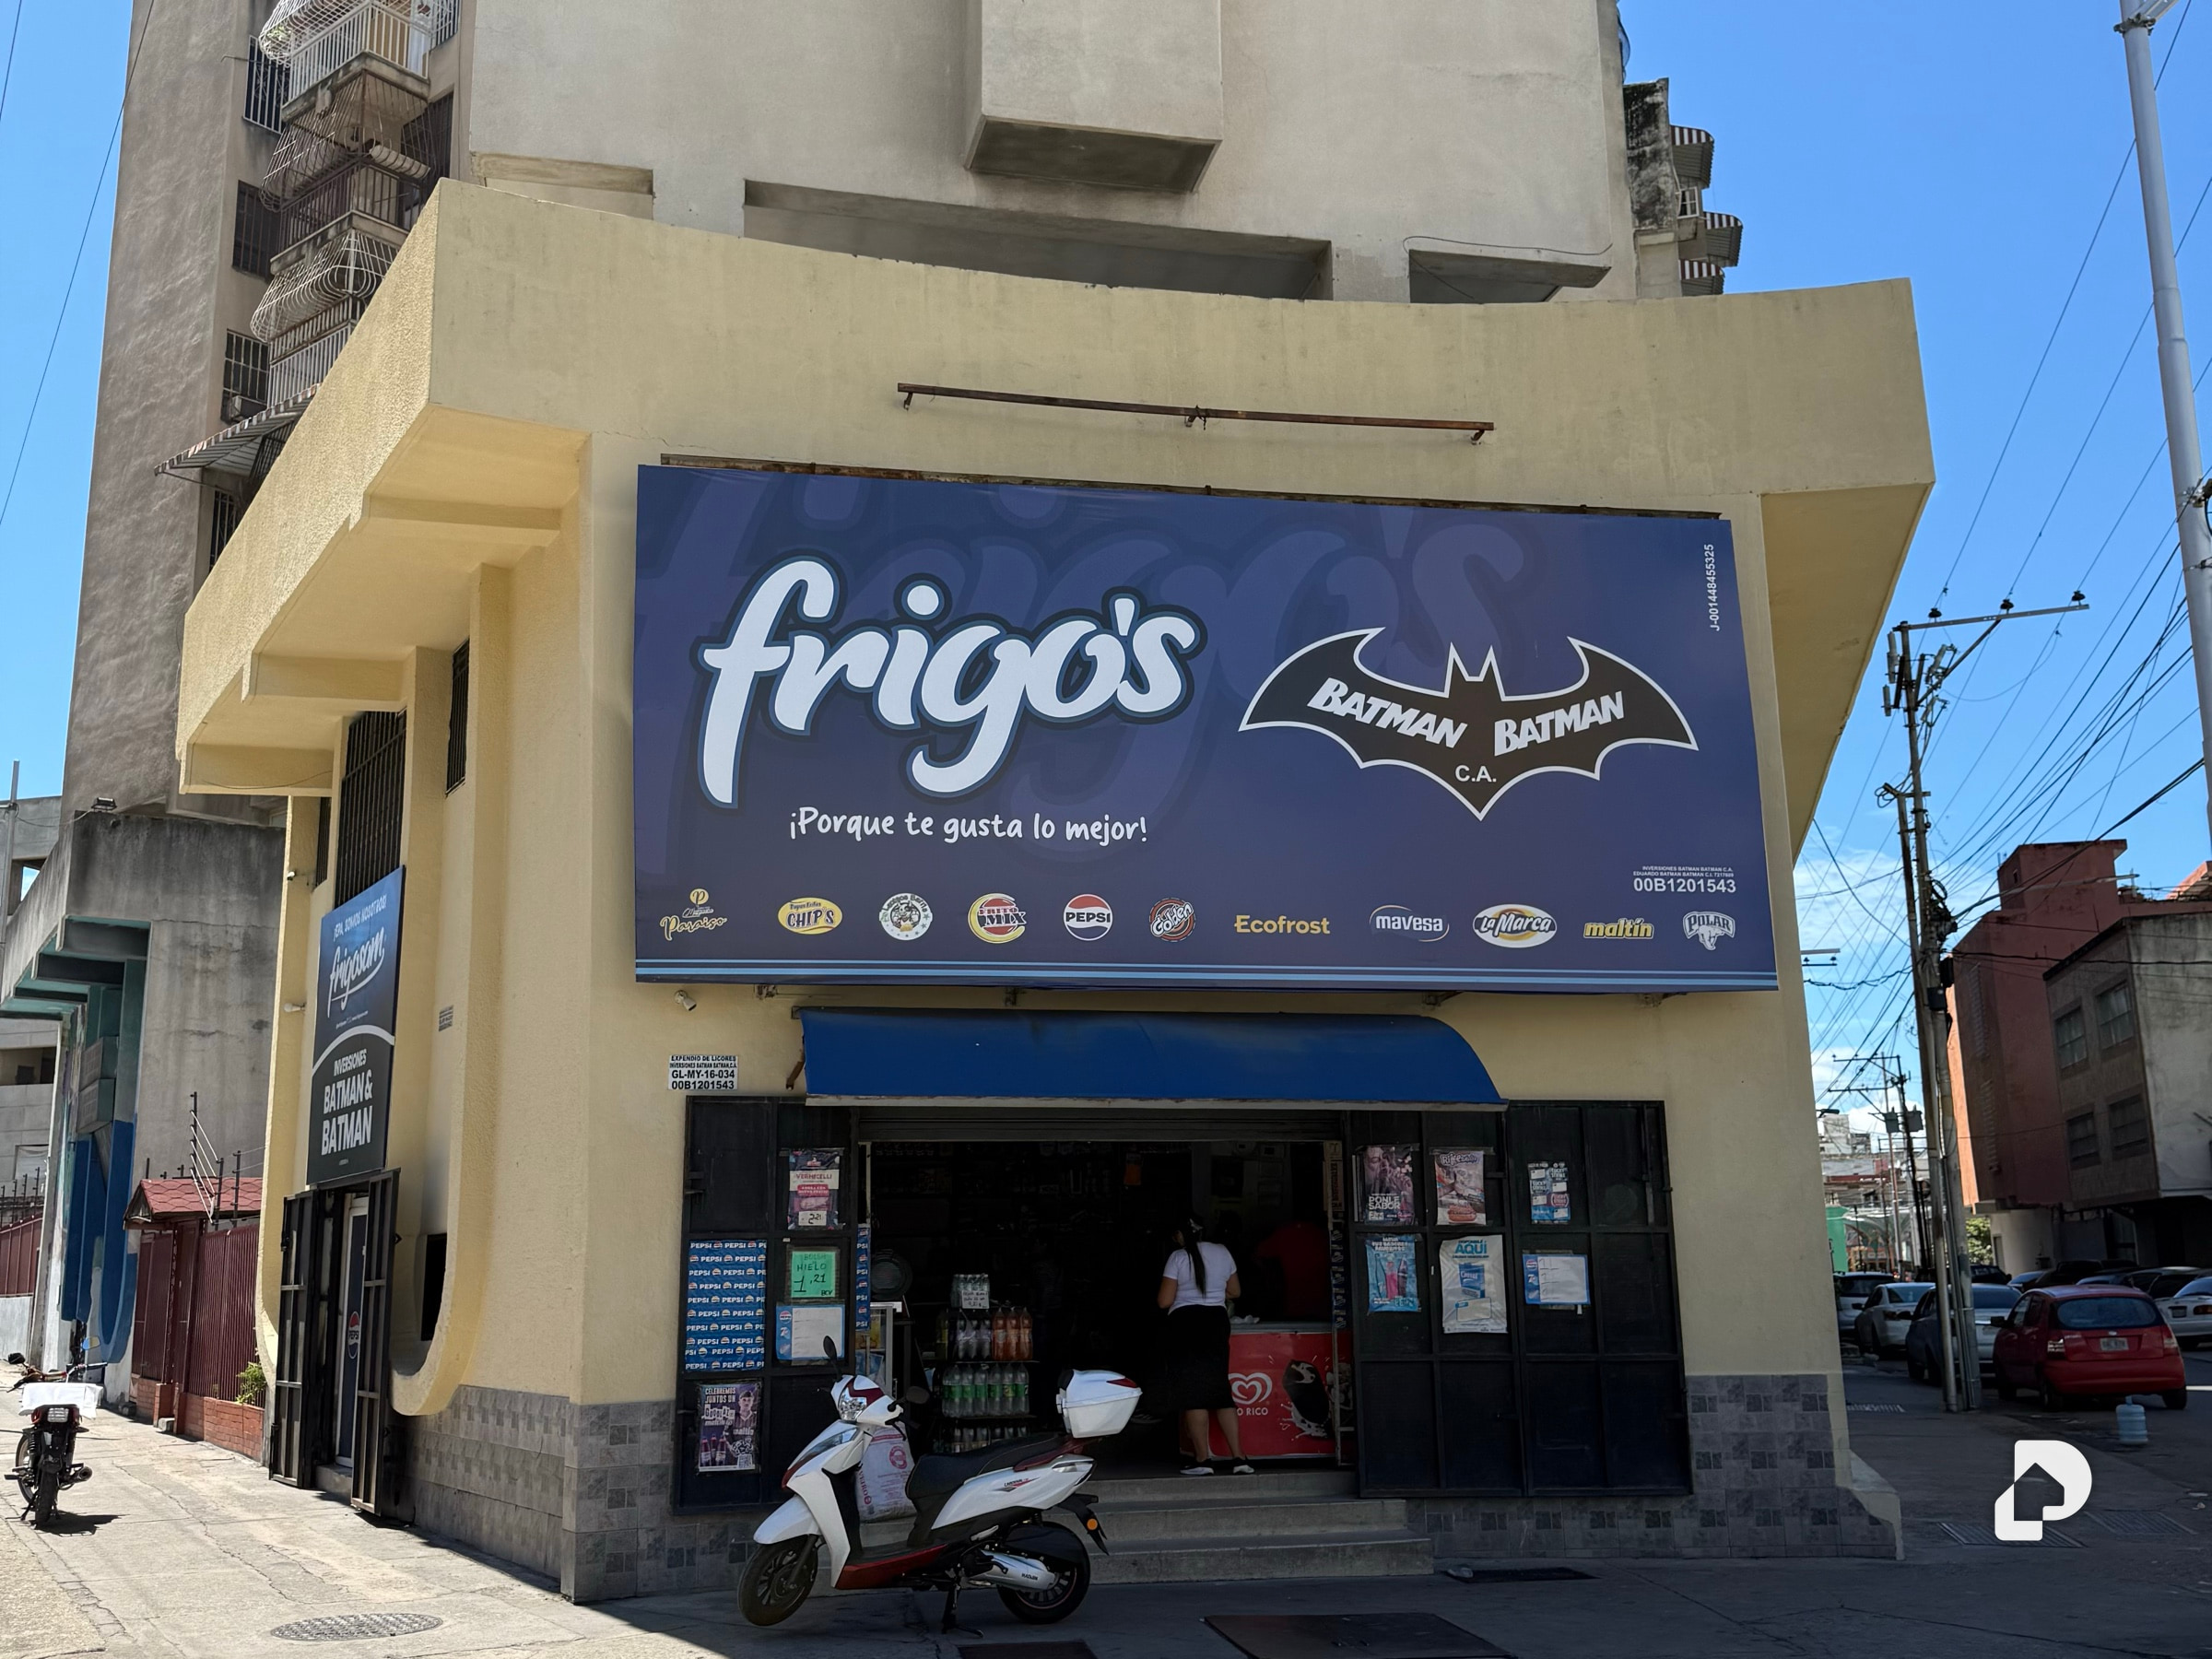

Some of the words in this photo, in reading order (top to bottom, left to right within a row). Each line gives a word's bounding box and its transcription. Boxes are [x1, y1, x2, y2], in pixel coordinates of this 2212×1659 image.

[1703, 543, 1721, 632] J-001448455325
[699, 555, 1201, 806] frigo's
[1307, 677, 1468, 748] BATMAN
[1494, 690, 1626, 757] BATMAN
[1454, 766, 1498, 783] C.A.
[790, 806, 895, 841] ¡Porque
[904, 812, 934, 837] te
[944, 813, 1023, 843] gusta
[1033, 813, 1056, 839] lo
[1065, 814, 1147, 847] mejor!
[1633, 877, 1736, 893] 00B1201543
[983, 912, 1028, 927] MIX
[1065, 912, 1111, 923] PEPSI
[1151, 902, 1194, 937] Golden
[1234, 914, 1331, 935] Ecofrost
[1375, 914, 1443, 932] mavesa
[1479, 916, 1496, 932] La
[1493, 912, 1552, 937] Marca
[1687, 914, 1731, 933] POLAR
[1583, 918, 1653, 939] maltín
[333, 1048, 367, 1077] INVERSIONES
[671, 1069, 735, 1078] GL-MY-16-034
[324, 1072, 365, 1114] BATMAN
[364, 1069, 373, 1100] &
[671, 1080, 735, 1089] 00B1201543
[321, 1105, 373, 1156] BATMAN
[1368, 1202, 1401, 1210] SABOR
[797, 1263, 827, 1272] HIELO
[1246, 1407, 1269, 1417] RICO
